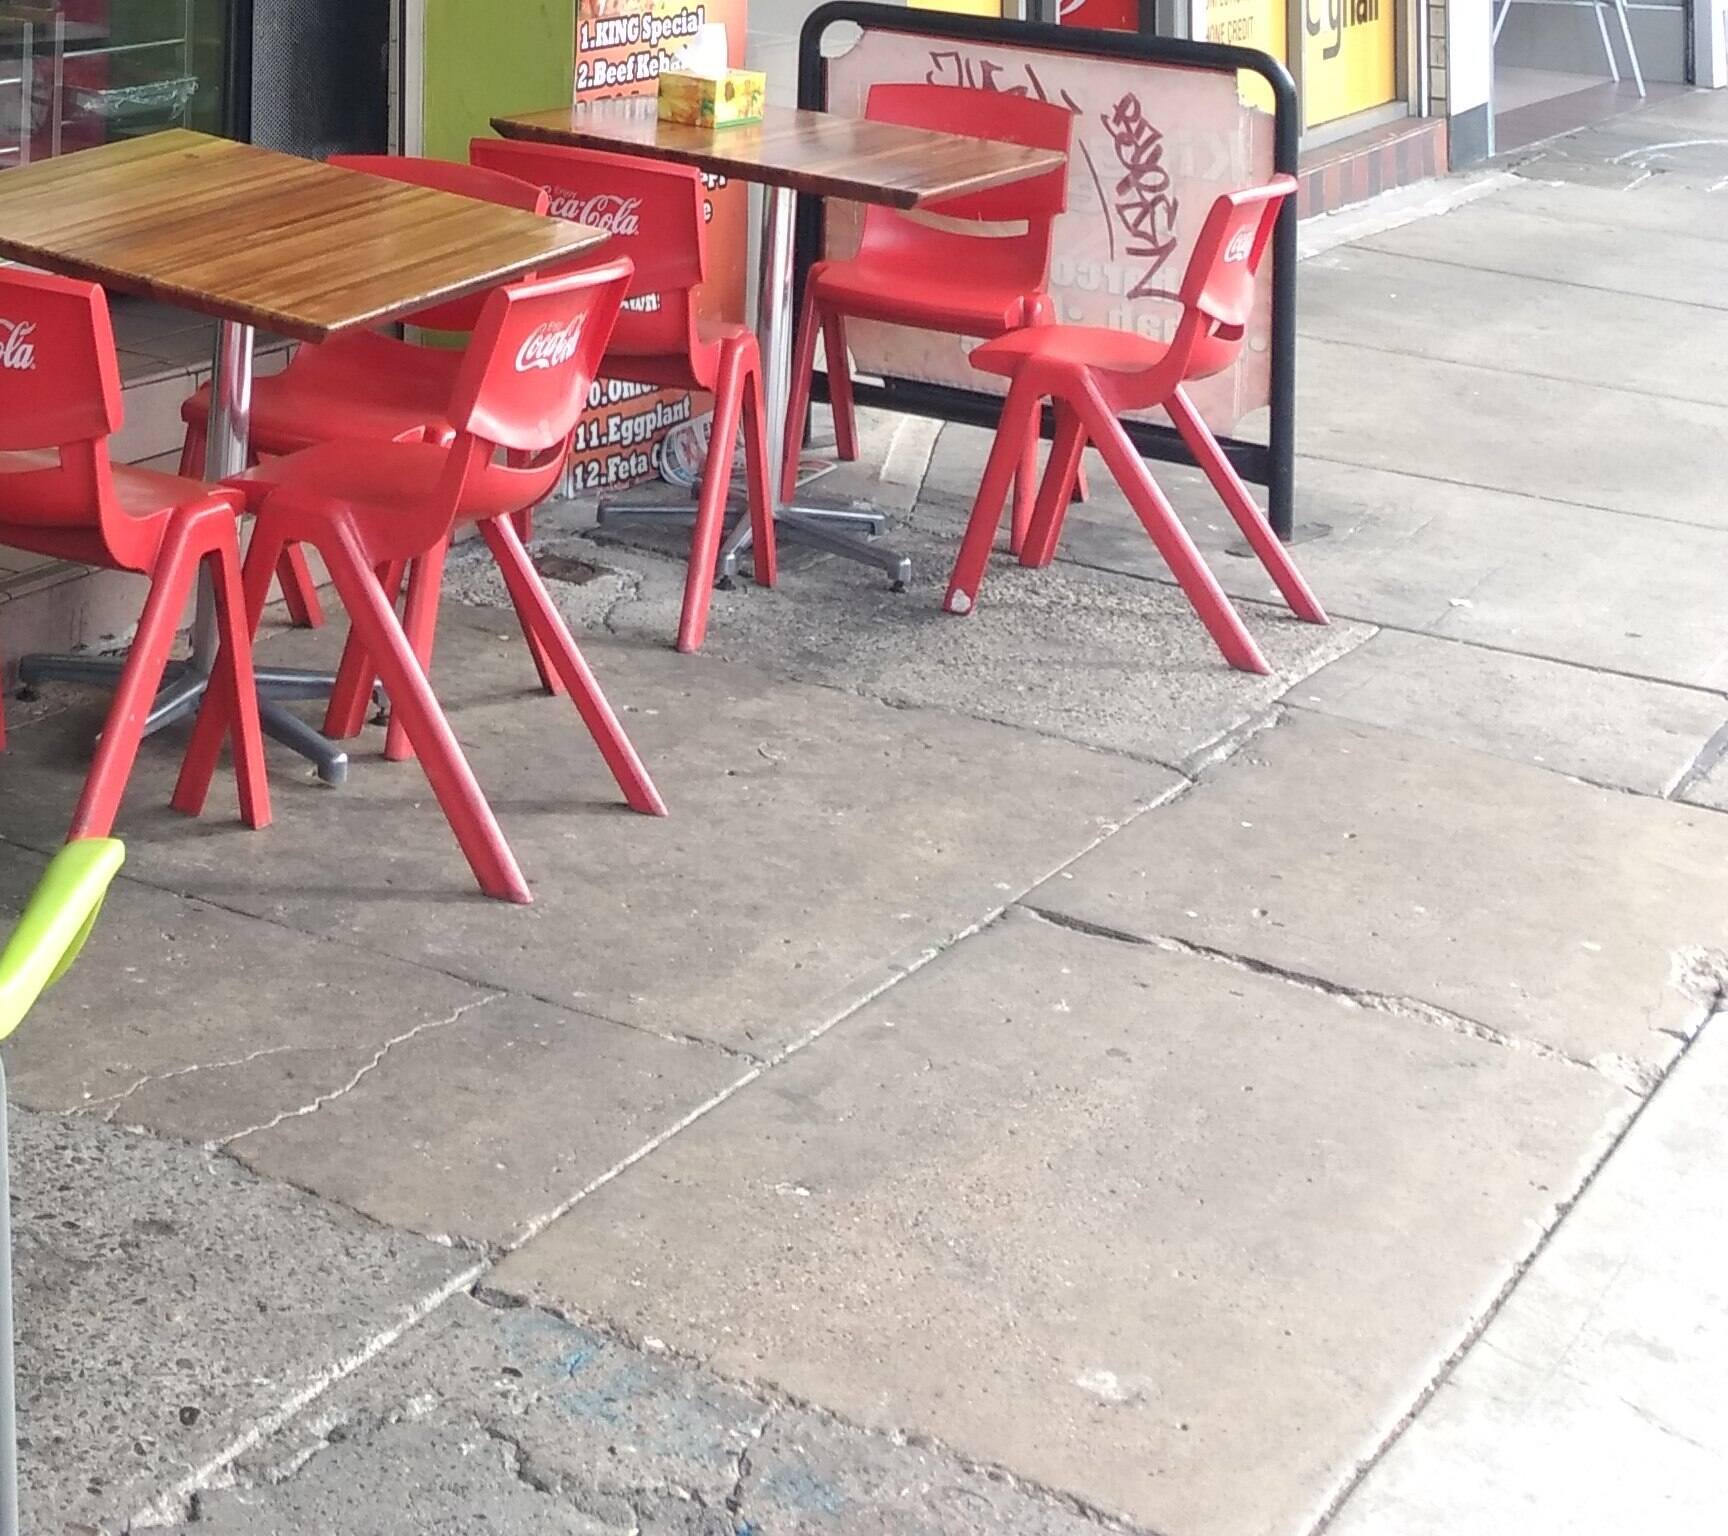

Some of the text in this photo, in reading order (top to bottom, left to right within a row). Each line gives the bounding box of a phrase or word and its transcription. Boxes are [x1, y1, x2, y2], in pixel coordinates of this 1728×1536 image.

[581, 8, 705, 49] 1.KING Special
[577, 54, 636, 89] 2.Beef
[575, 393, 691, 453] 11.Eggplant
[574, 451, 649, 491] 12.Feta
